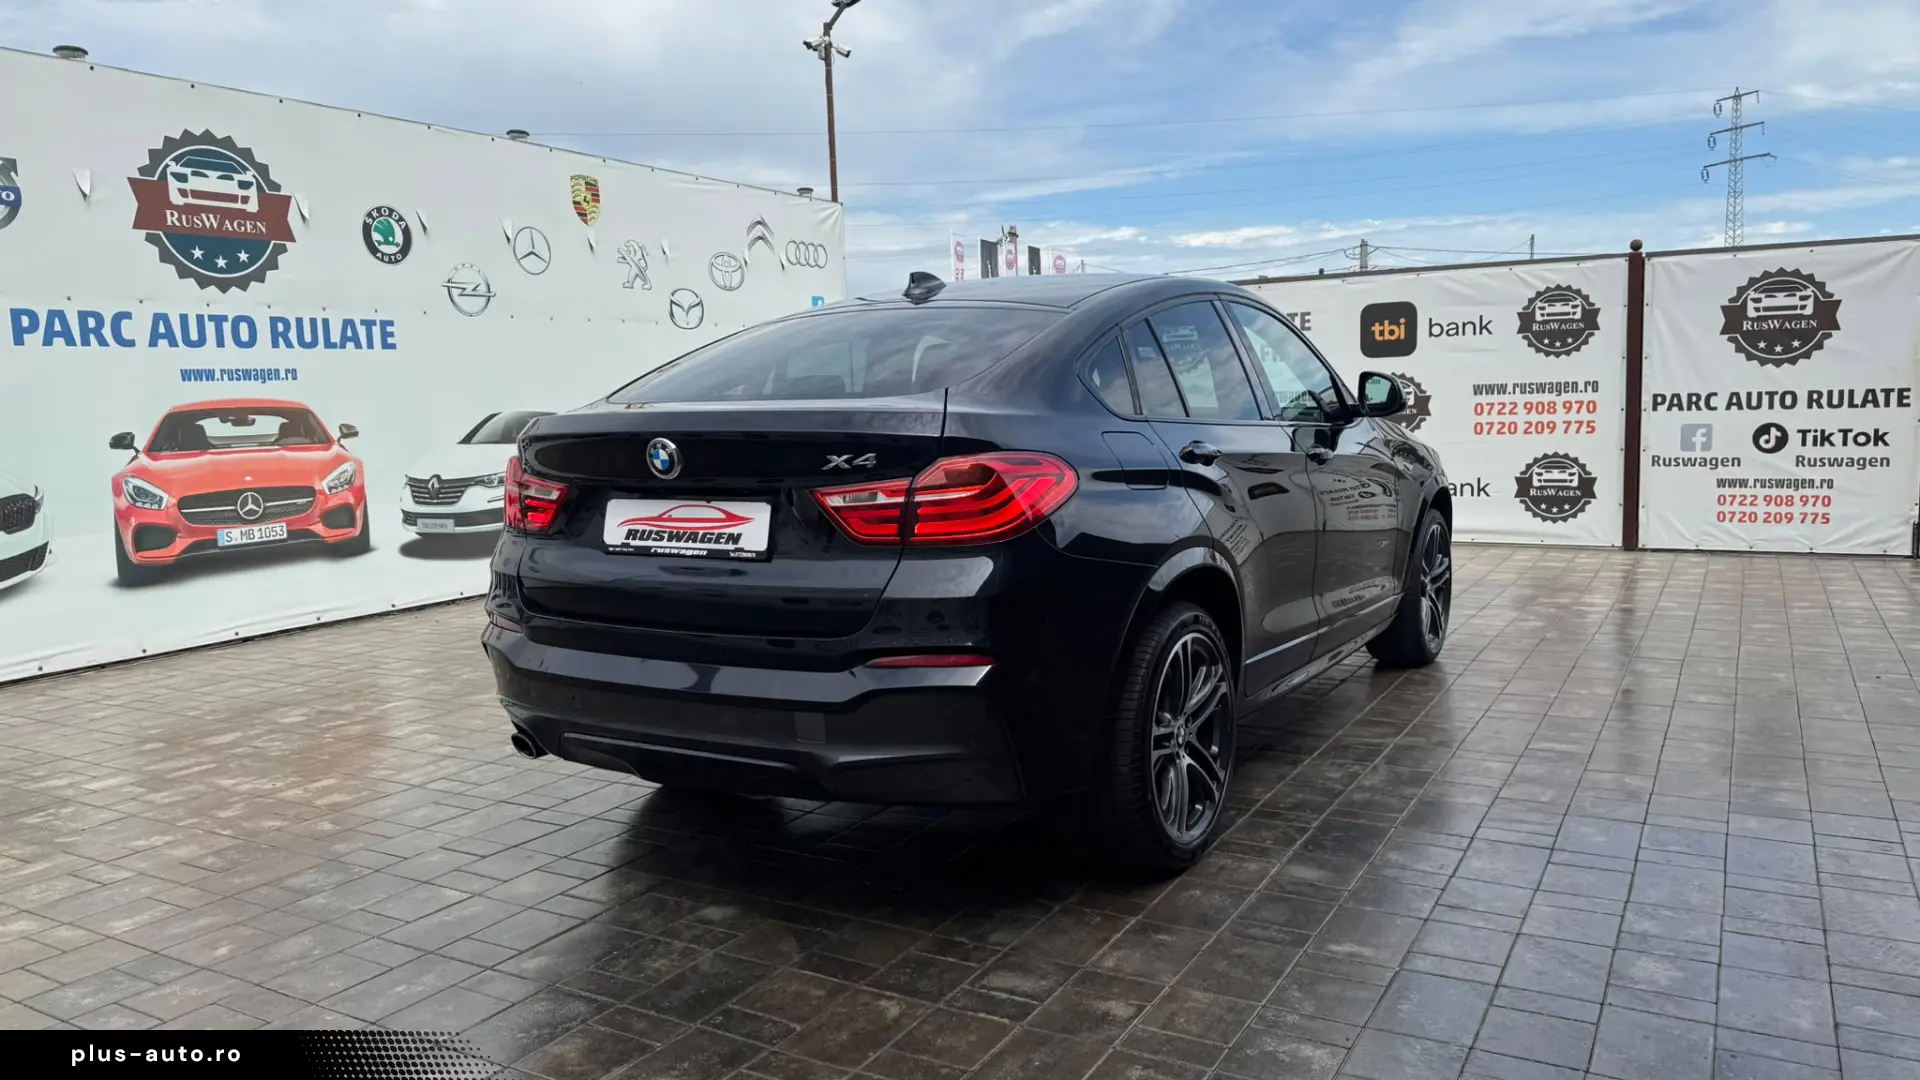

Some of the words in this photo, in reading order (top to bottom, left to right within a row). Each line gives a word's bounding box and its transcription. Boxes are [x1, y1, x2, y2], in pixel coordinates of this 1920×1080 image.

[375, 251, 402, 262] AUTO
[10, 307, 136, 348] PARC
[148, 311, 258, 350] AUTO
[269, 315, 398, 350] RULATE
[1371, 318, 1407, 342] tbi
[1428, 315, 1494, 338] bank
[180, 367, 299, 384] www.ruswagen.ro
[1472, 379, 1600, 398] www.ruswagen.ro
[1473, 402, 1519, 416] 0722
[1523, 401, 1558, 416] 908
[1562, 400, 1598, 415] 970
[1651, 391, 1718, 412] PARC
[1725, 390, 1798, 411] AUTO
[1807, 387, 1912, 410] RULATE
[1473, 421, 1518, 436] 0720
[1523, 420, 1557, 435] 209
[1562, 420, 1597, 435] 775
[1796, 428, 1891, 448] TikTok
[820, 452, 877, 470] X4
[1651, 454, 1742, 470] Ruswagen
[1795, 454, 1891, 471] Ruswagen
[1448, 476, 1491, 497] ank
[1716, 477, 1834, 491] www.ruswagen.ro
[1717, 494, 1759, 507] 0722
[1762, 494, 1795, 507] 908
[1799, 494, 1832, 507] 970
[1716, 511, 1758, 524] 0720
[1762, 511, 1794, 524] 209
[1799, 511, 1831, 525] 775
[225, 531, 233, 543] S
[240, 528, 255, 541] MB
[257, 525, 285, 539] 1053
[624, 528, 743, 546] RUSWAGEN
[651, 547, 708, 556] ruswagen
